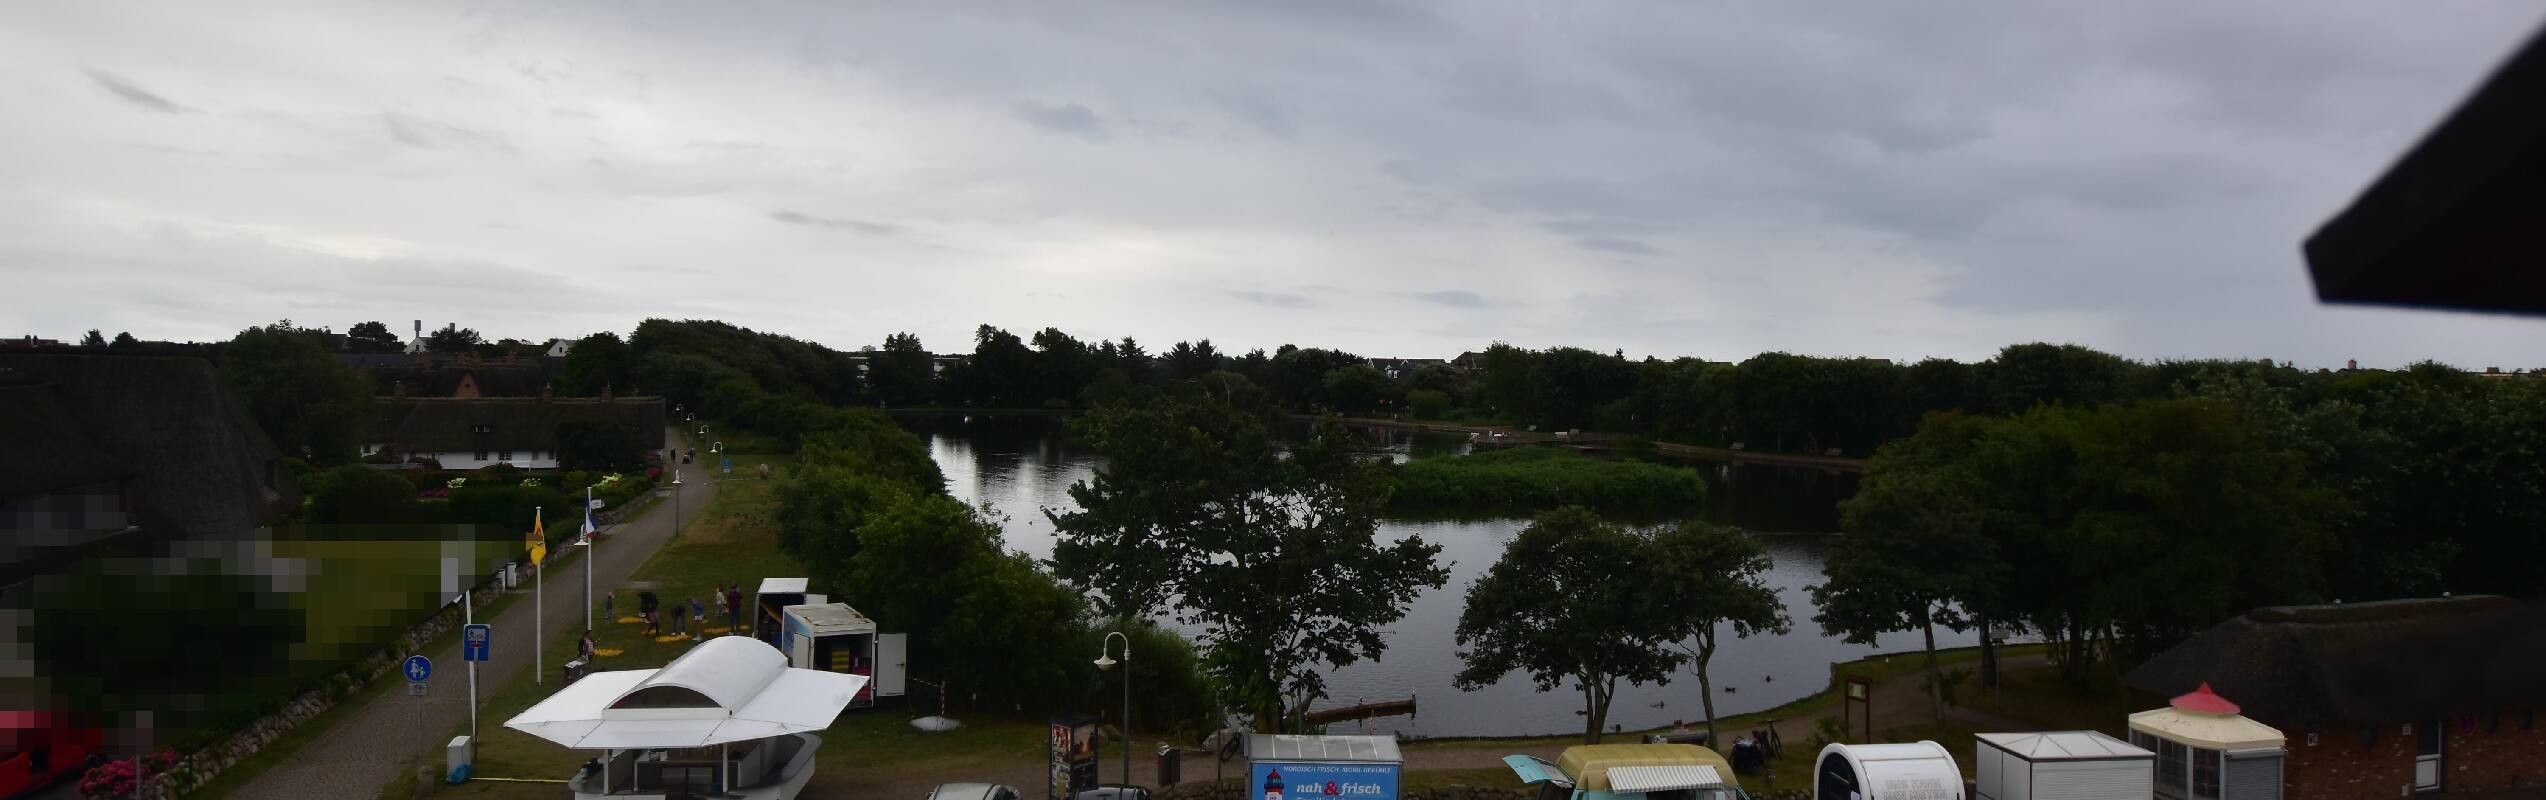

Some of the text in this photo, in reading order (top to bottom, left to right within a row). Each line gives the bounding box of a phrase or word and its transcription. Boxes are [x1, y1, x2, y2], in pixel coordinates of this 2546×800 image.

[1297, 780, 1381, 796] nah & frisch
